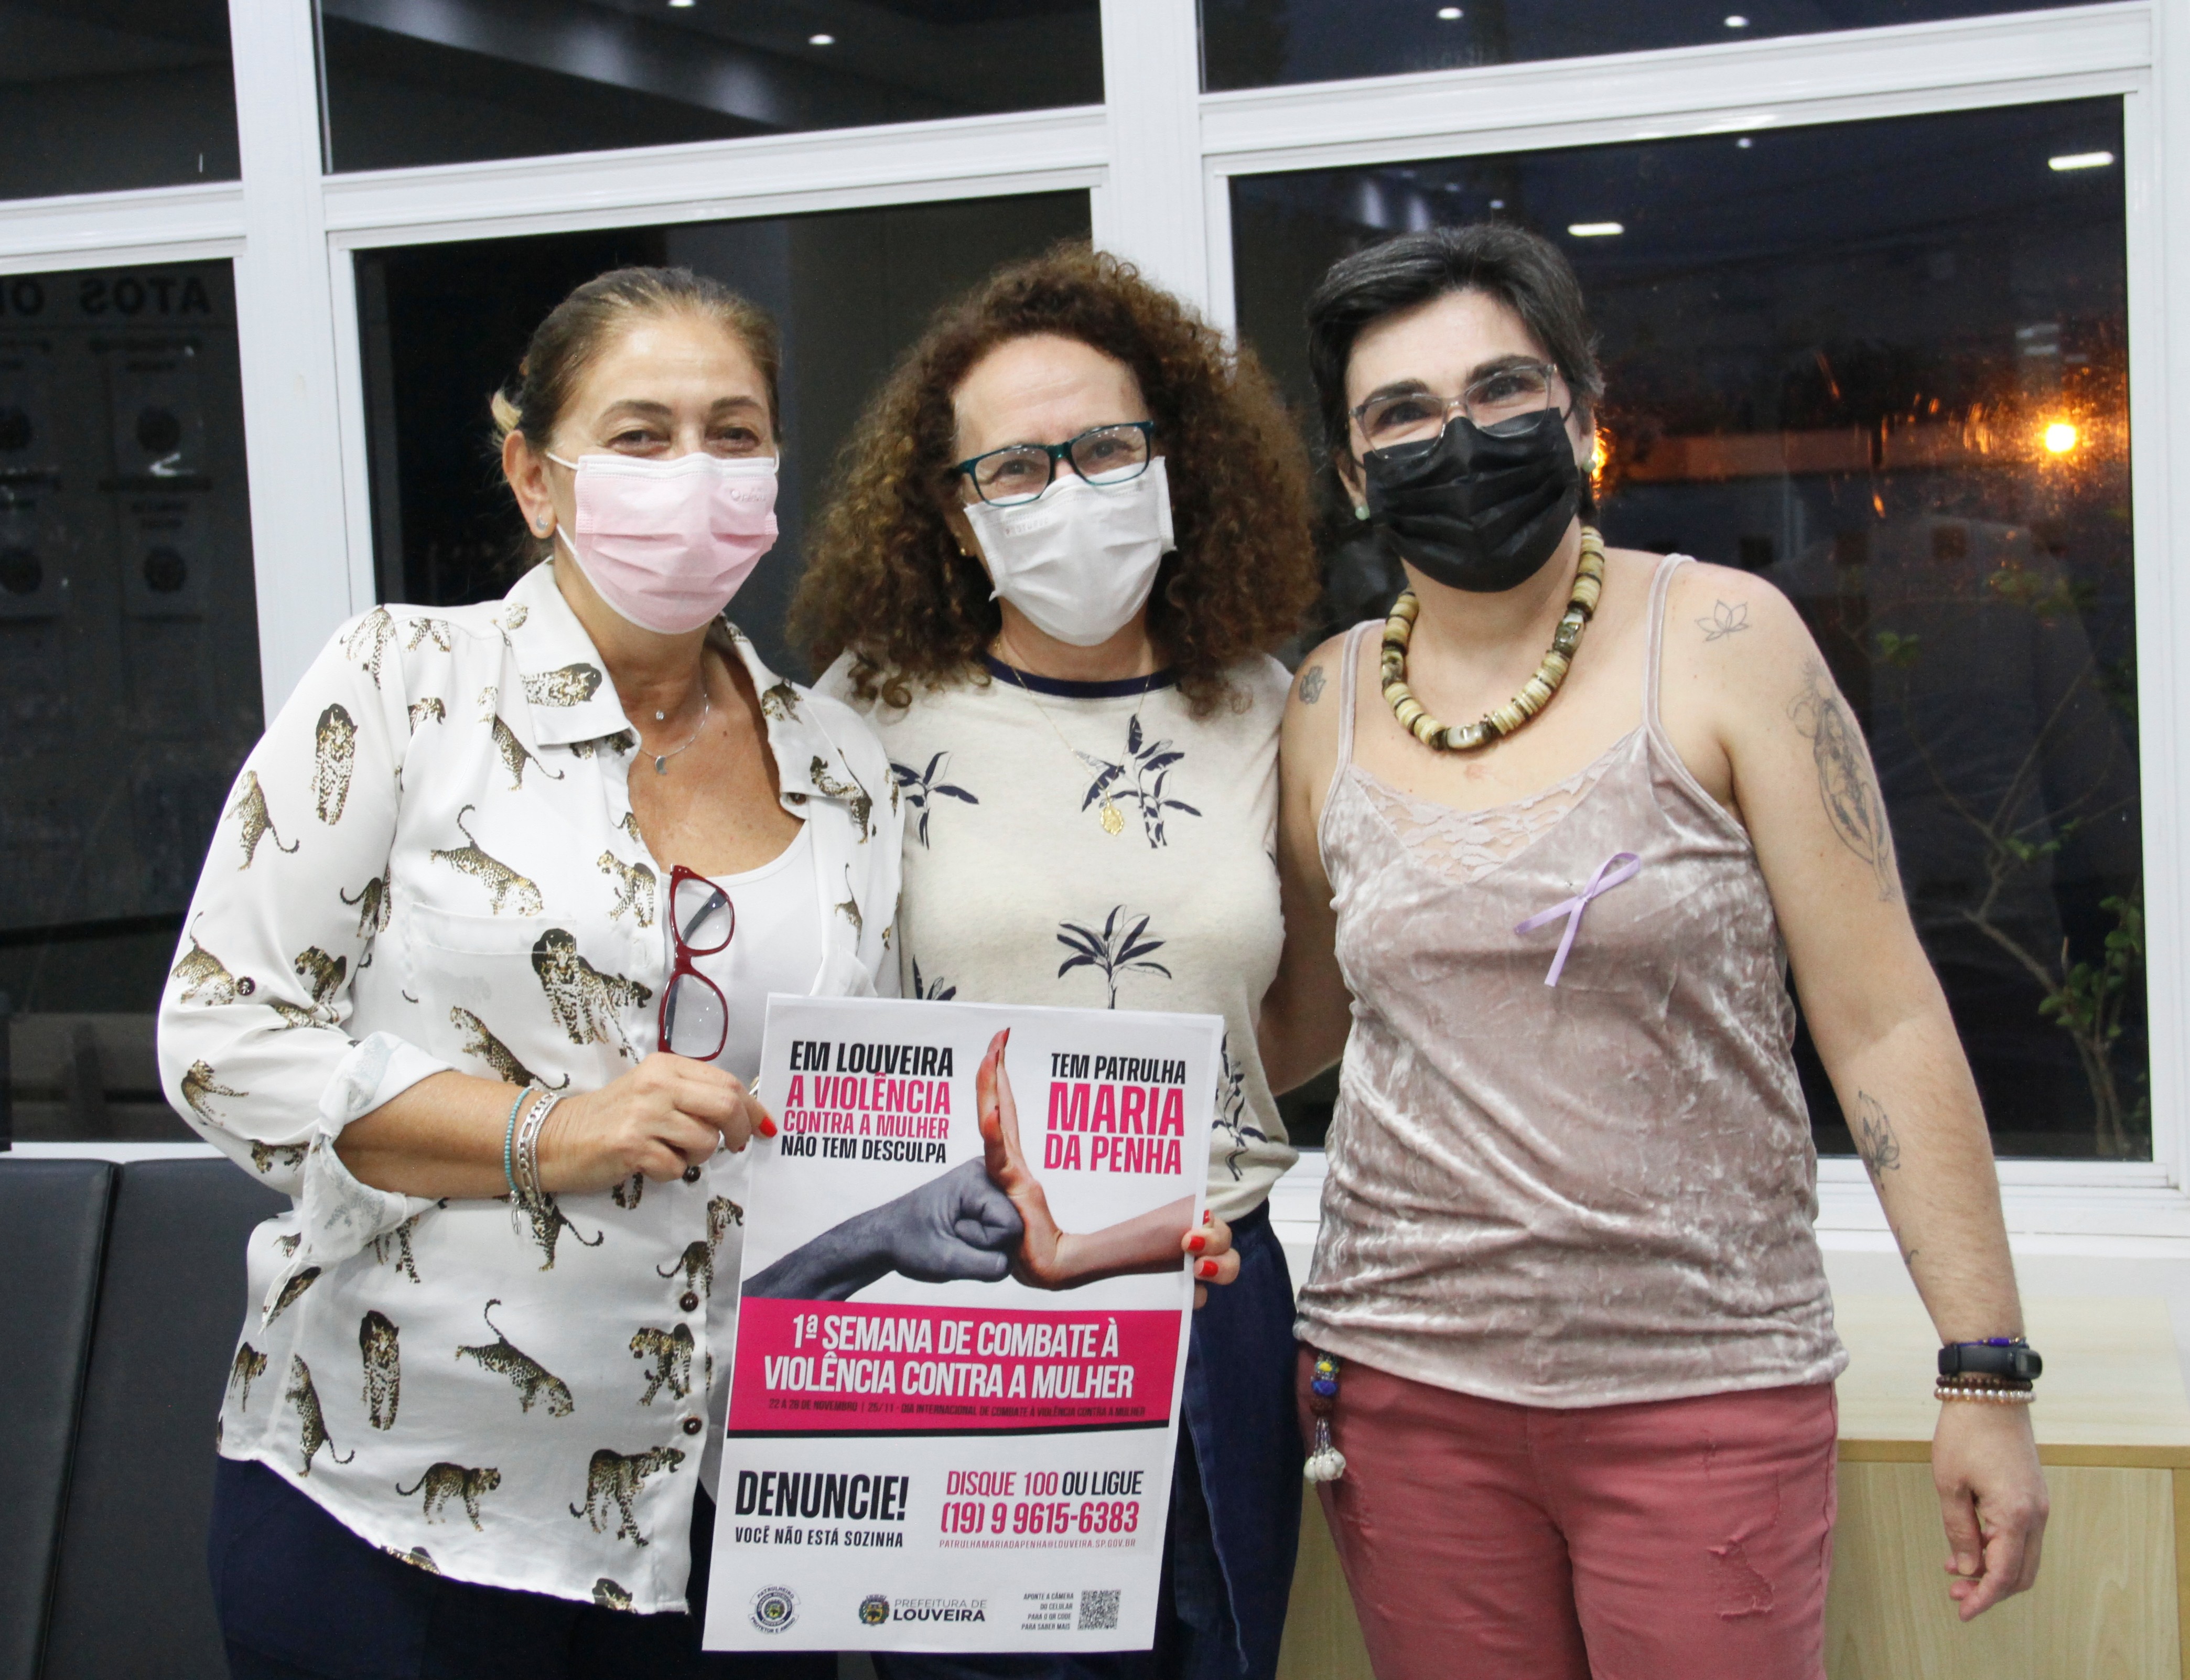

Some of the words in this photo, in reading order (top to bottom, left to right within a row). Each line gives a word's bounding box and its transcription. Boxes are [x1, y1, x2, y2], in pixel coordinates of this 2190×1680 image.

[790, 1041, 830, 1071] EM
[836, 1043, 953, 1077] LOUVEIRA
[1051, 1053, 1089, 1079] TEM
[1094, 1056, 1185, 1084] PATRULHA
[786, 1075, 804, 1107] A
[815, 1072, 950, 1114] VIOLÊNCIA
[783, 1110, 854, 1135] CONTRA
[859, 1114, 870, 1135] A
[876, 1115, 949, 1139] MULHER
[1047, 1082, 1184, 1137] MARIA
[781, 1132, 817, 1157] NÃO
[822, 1137, 857, 1159] TEM
[862, 1139, 946, 1164] DESCULPA
[1044, 1134, 1081, 1170] DA
[1090, 1136, 1181, 1175] PENHA
[793, 1314, 818, 1349] 1ª
[822, 1315, 932, 1353] SEMANA
[938, 1319, 974, 1355] DE
[977, 1321, 1099, 1358] COMBATE
[1101, 1317, 1119, 1358] À
[764, 1351, 896, 1394] VIOLÊNCIA
[901, 1361, 1003, 1398] CONTRA
[1008, 1365, 1026, 1398] A
[1031, 1365, 1134, 1399] MULHER
[769, 1398, 780, 1408] 22
[781, 1399, 786, 1408] A
[801, 1400, 811, 1410] DE
[814, 1400, 858, 1412] NOVEMBRO
[980, 1406, 989, 1416] DE
[991, 1406, 1028, 1417] COMBATE
[735, 1470, 909, 1521] DENUNCIE!
[946, 1471, 1017, 1497] DISQUE
[1024, 1471, 1059, 1496] 100
[1062, 1471, 1088, 1496] OU
[1091, 1471, 1144, 1495] LIGUE
[941, 1502, 985, 1534] (19)
[991, 1503, 1007, 1534] 9
[1013, 1501, 1139, 1534] 9615-6383
[736, 1525, 770, 1544] VOCÊ
[774, 1525, 802, 1545] NÃO
[807, 1528, 839, 1546] ESTÁ
[844, 1531, 903, 1547] SOZINHA
[894, 1599, 967, 1608] PREFEITURA
[971, 1599, 987, 1609] DE
[1051, 1591, 1074, 1600] CÂMERA
[893, 1609, 985, 1621] LOUVEIRA
